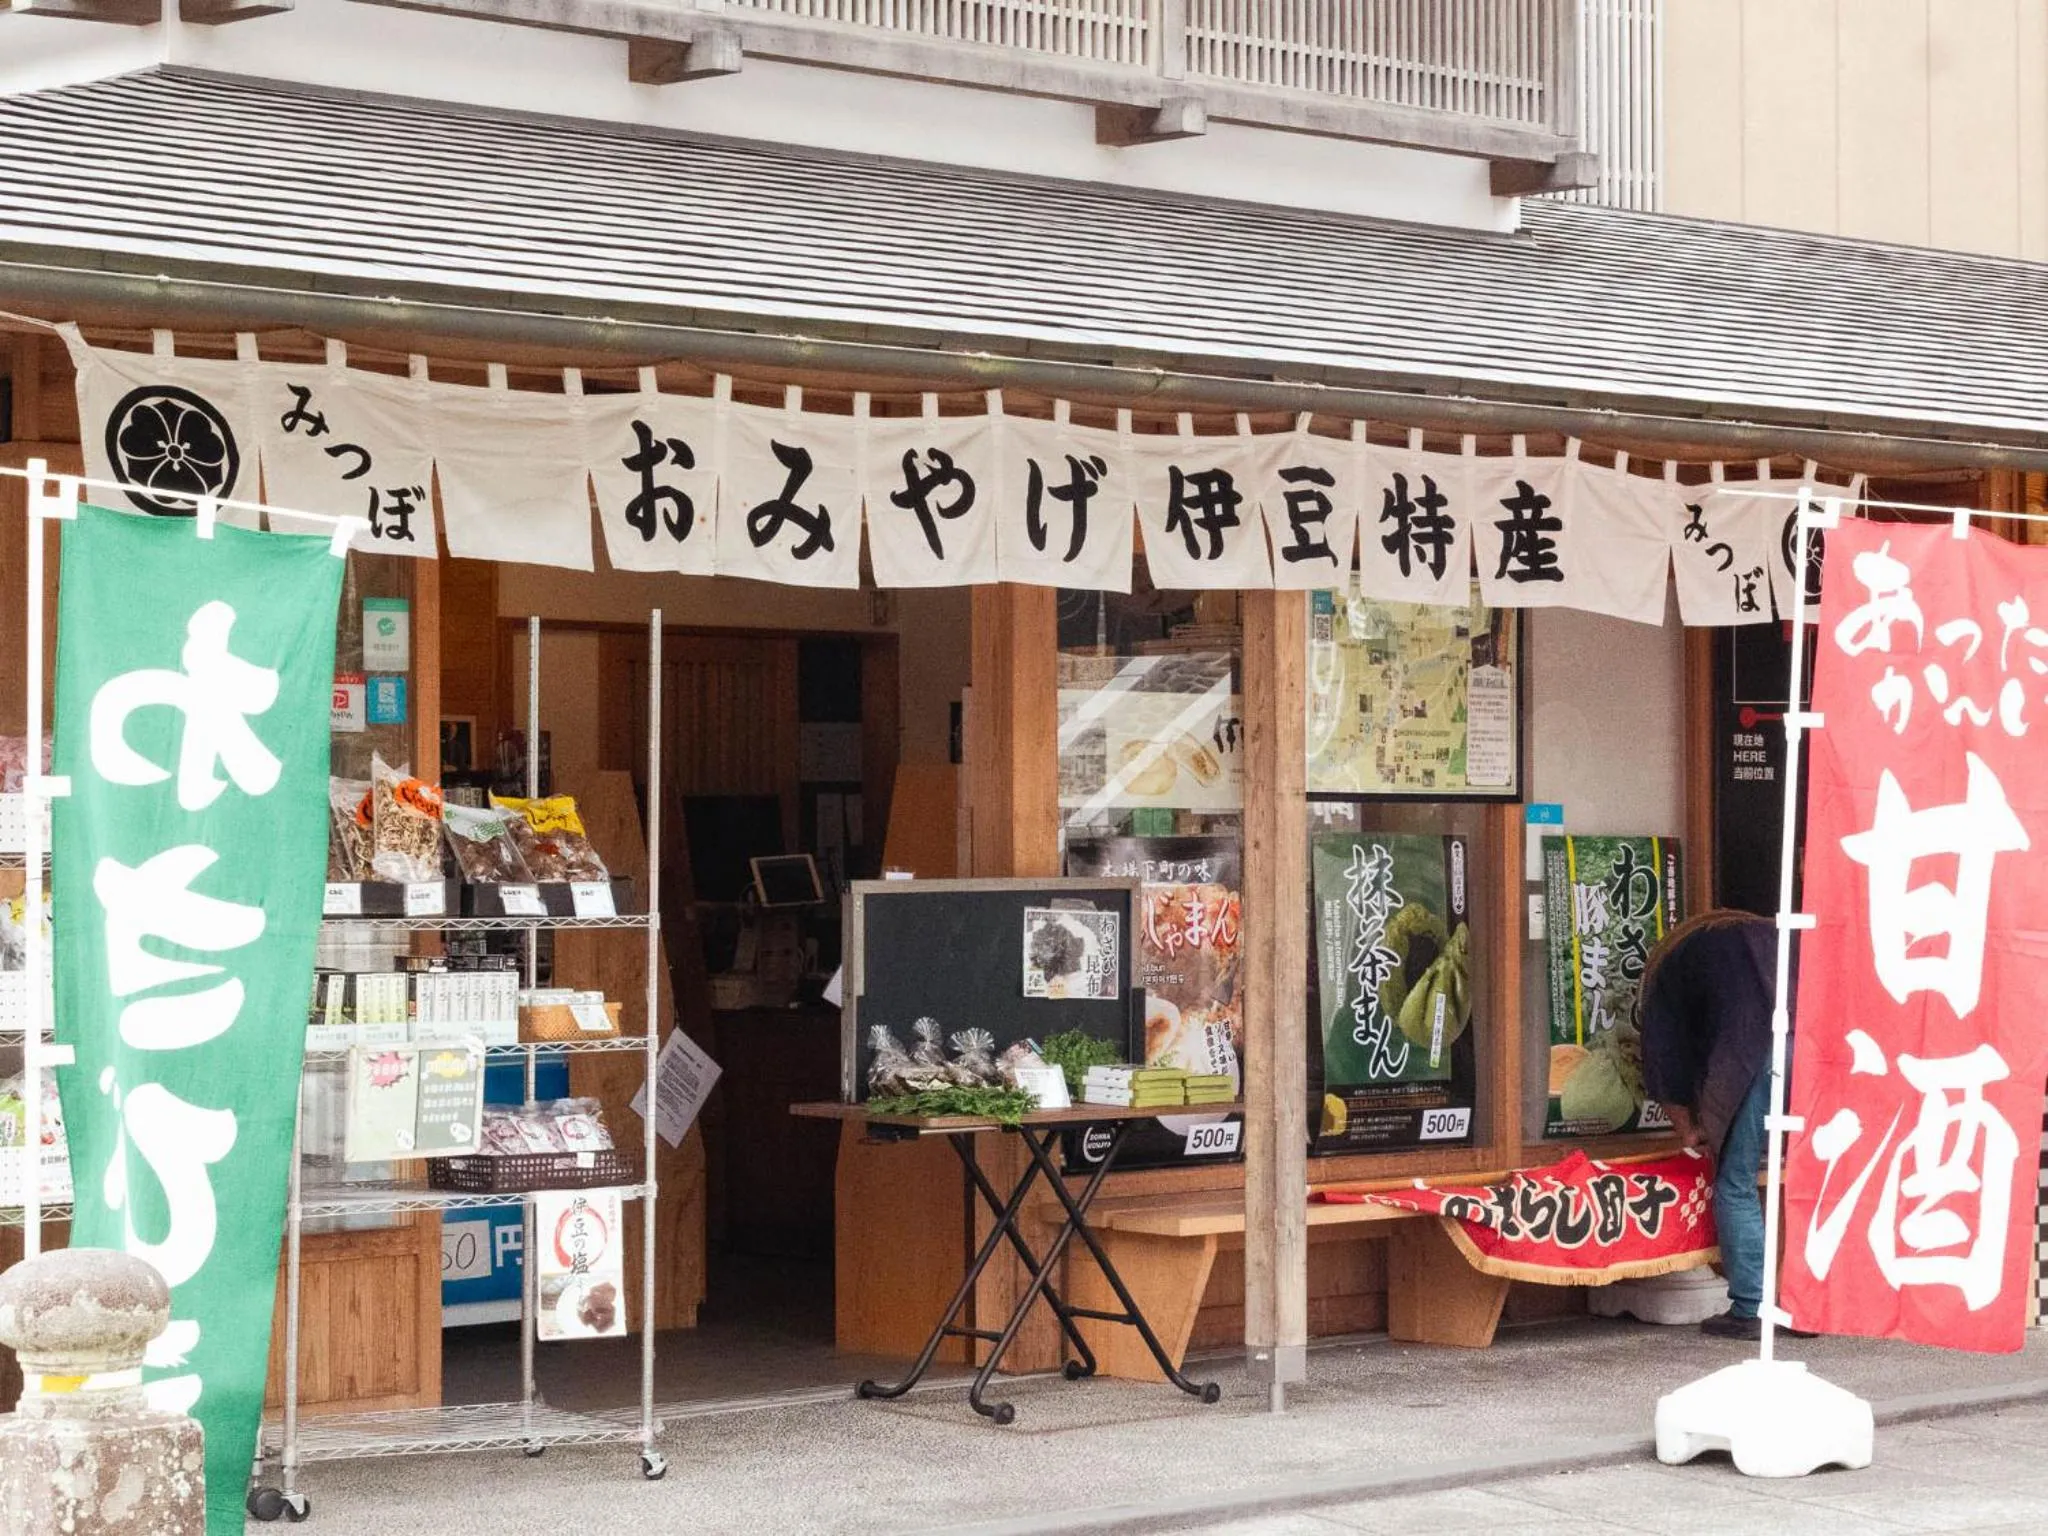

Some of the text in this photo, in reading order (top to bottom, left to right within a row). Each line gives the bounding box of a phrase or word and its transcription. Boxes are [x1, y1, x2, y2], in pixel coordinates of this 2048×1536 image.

[280, 382, 426, 541] みつぼ
[1683, 503, 1764, 613] みつぼ
[1733, 750, 1767, 762] HERE
[1142, 891, 1238, 958] じゃまん
[1344, 843, 1409, 1079] 抹茶まん
[1573, 881, 1616, 1034] 豚まん
[1804, 751, 2031, 1311] 甘酒
[1192, 1127, 1234, 1149] 500円
[1427, 1113, 1465, 1134] 500円
[1645, 1104, 1669, 1123] 50
